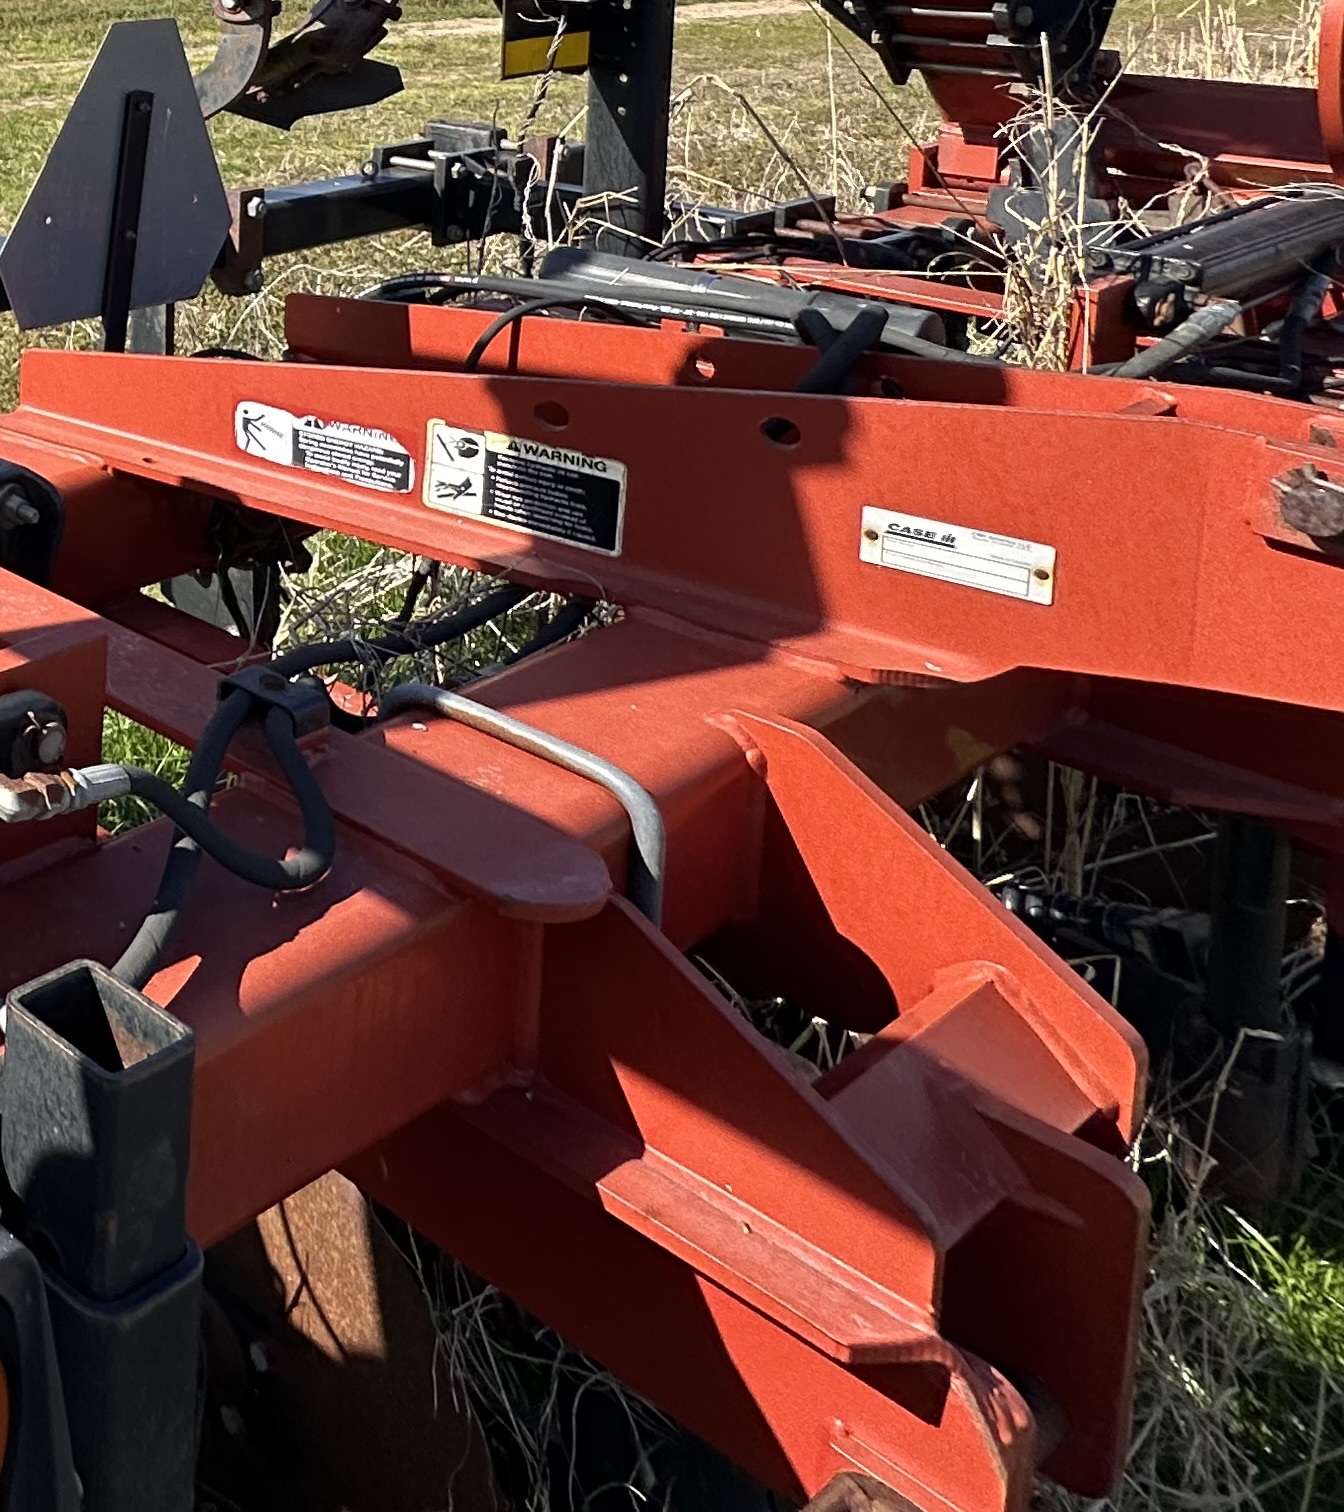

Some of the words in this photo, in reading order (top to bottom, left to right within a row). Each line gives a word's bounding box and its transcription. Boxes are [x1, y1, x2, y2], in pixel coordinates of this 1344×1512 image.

[329, 420, 399, 443] WARNIN
[522, 441, 608, 475] WARNING
[886, 522, 935, 539] CASE
